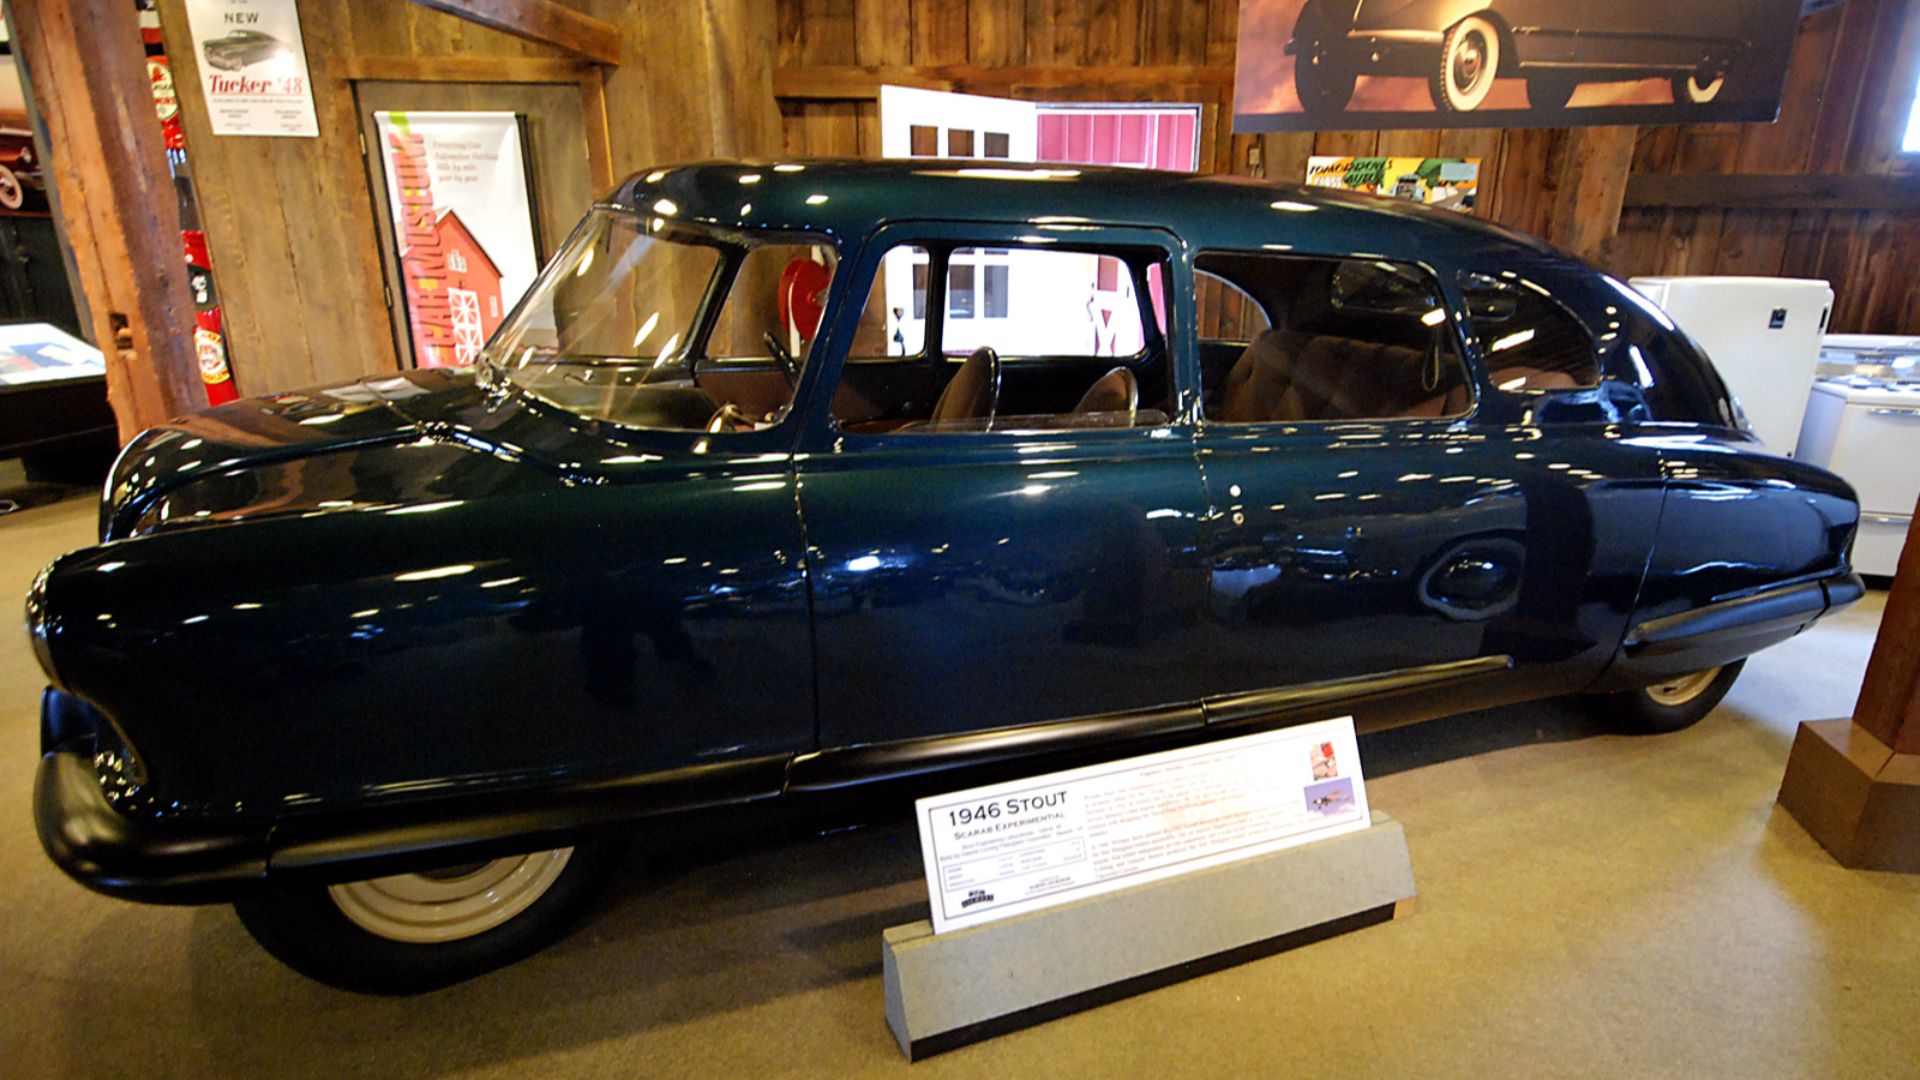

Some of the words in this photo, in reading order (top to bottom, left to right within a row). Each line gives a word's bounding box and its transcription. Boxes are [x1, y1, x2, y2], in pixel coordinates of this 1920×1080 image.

[224, 12, 259, 23] NEW
[209, 74, 272, 93] Tucker
[388, 134, 447, 279] MUSEUM
[416, 292, 456, 347] CAR
[949, 803, 1001, 827] 1946
